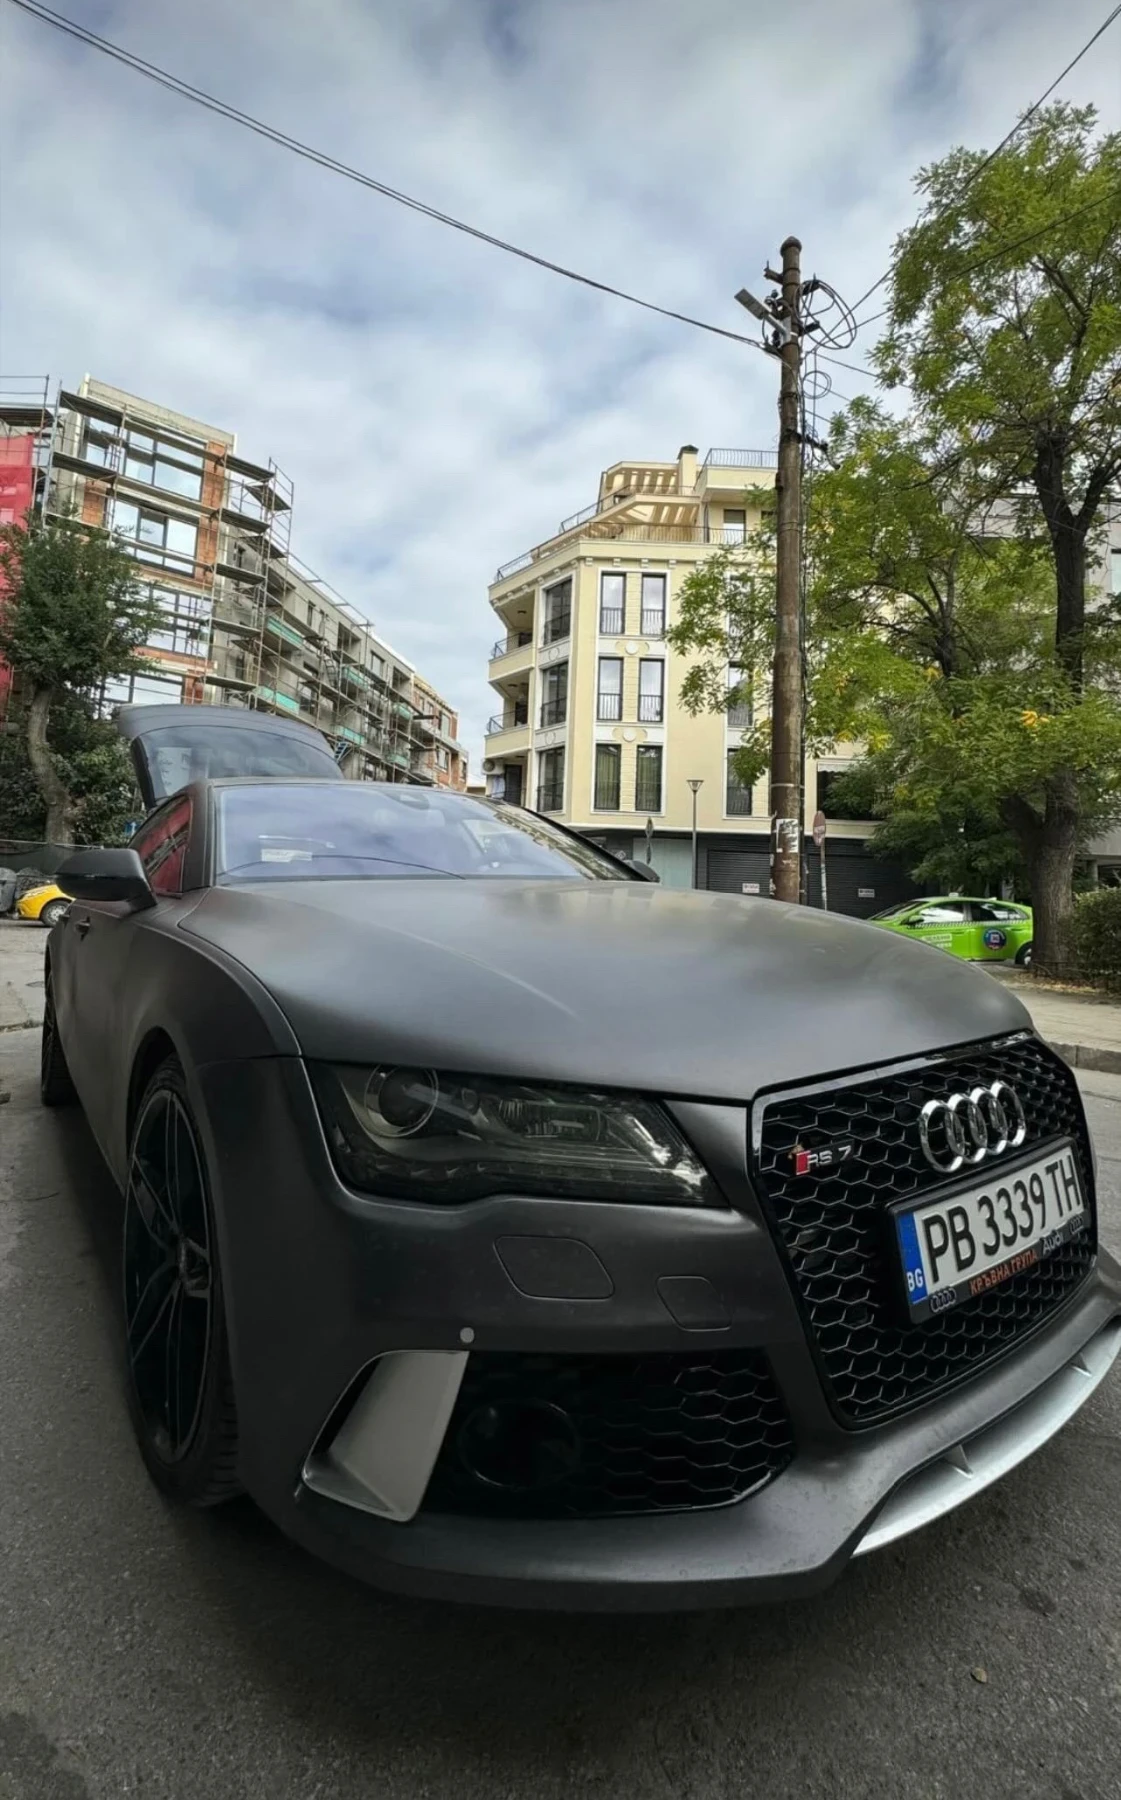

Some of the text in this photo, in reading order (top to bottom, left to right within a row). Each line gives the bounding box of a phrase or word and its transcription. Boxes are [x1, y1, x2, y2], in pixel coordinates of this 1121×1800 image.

[922, 1154, 1081, 1284] PB 3339 TH
[906, 1268, 924, 1292] BG
[968, 1248, 1039, 1296] КРЪВНА ГРУПА
